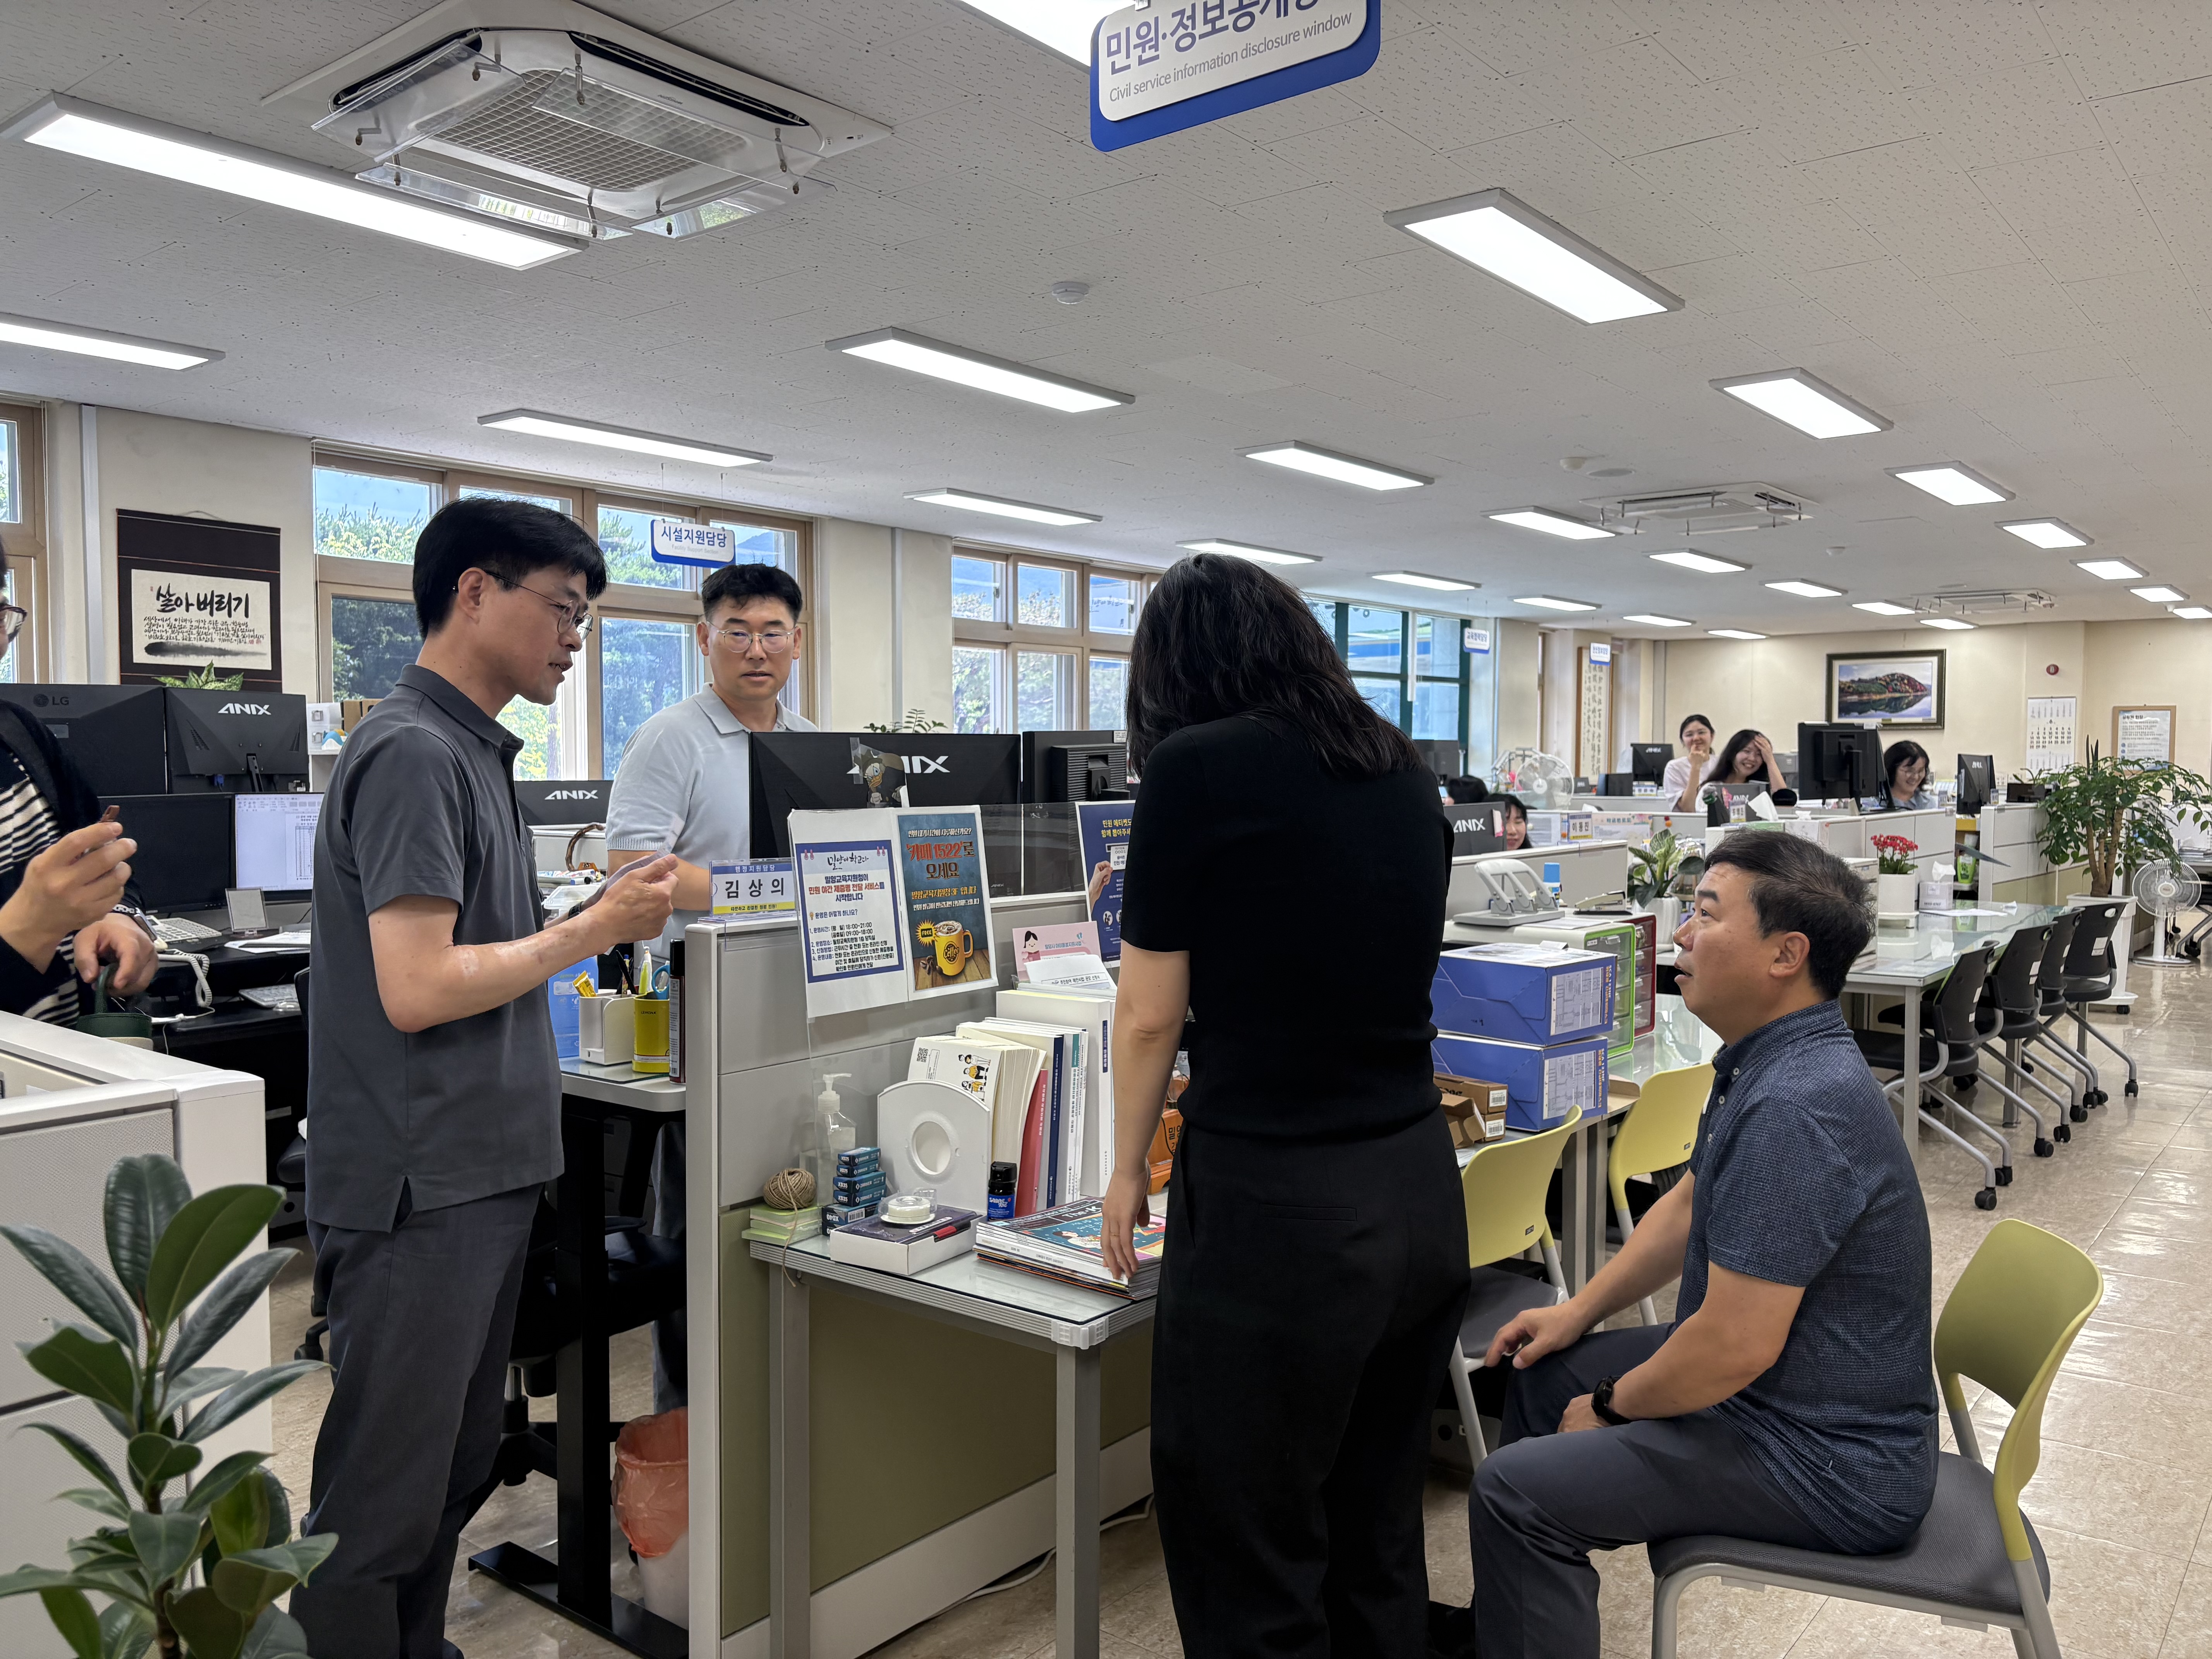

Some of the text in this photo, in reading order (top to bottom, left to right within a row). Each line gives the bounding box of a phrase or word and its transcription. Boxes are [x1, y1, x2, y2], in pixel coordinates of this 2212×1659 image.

[1110, 11, 1352, 103] Civil service information disclosure window
[661, 526, 727, 548] 시설지원담당
[52, 696, 69, 706] LG
[218, 703, 272, 716] ANIX
[544, 790, 599, 801] ANIX
[1103, 819, 1113, 828] 민원
[1453, 818, 1486, 833] ANIX
[1101, 829, 1111, 838] 함께
[926, 862, 960, 880] 오세요
[824, 874, 869, 884] 밀양교육지원청이
[809, 887, 821, 895] 민원
[834, 884, 851, 893] 제증명
[864, 882, 885, 890] 서비스를
[835, 893, 863, 902] 시작합니다
